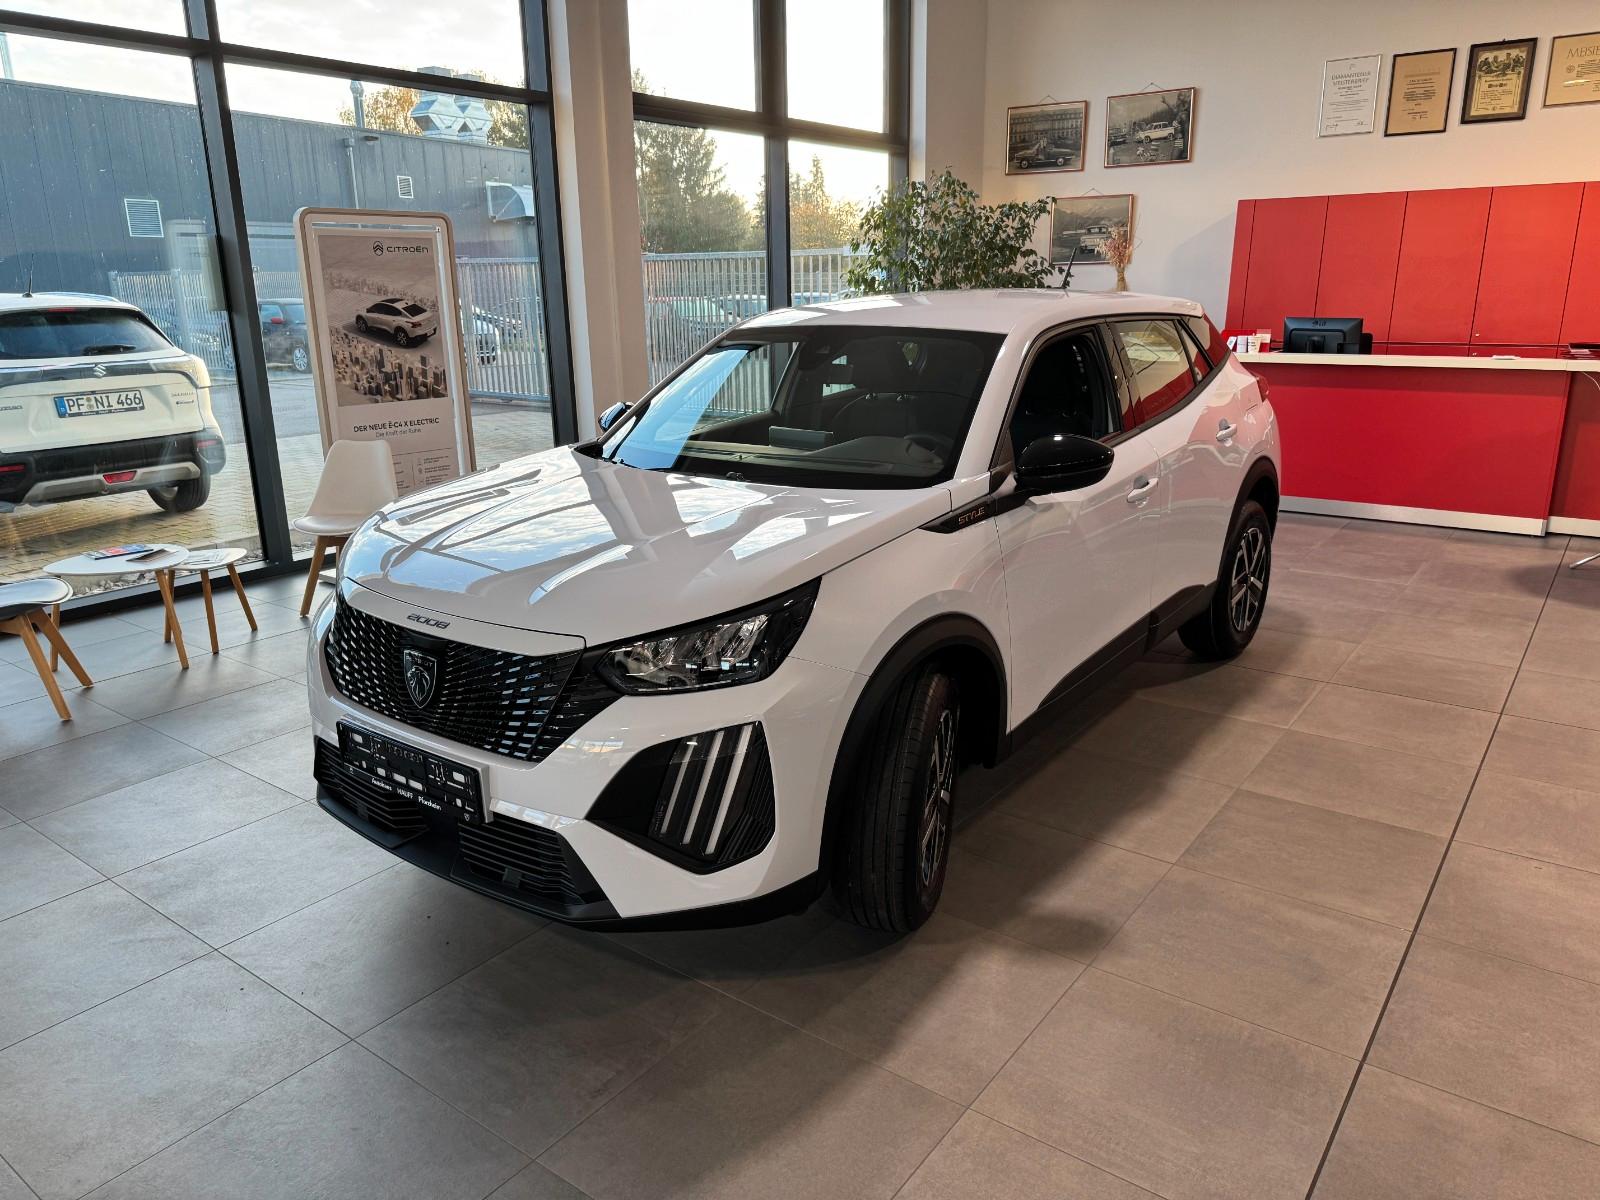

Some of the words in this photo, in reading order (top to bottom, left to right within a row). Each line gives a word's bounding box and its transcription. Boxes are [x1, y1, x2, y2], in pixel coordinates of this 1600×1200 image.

[66, 397, 85, 411] PF
[95, 395, 114, 409] NI
[116, 393, 142, 407] 466
[353, 424, 368, 432] DER
[369, 422, 387, 430] NEUE
[409, 418, 440, 426] ELECTRIC
[958, 506, 985, 525] STYLE
[406, 613, 451, 629] 2008
[396, 787, 414, 800] HAUFF
